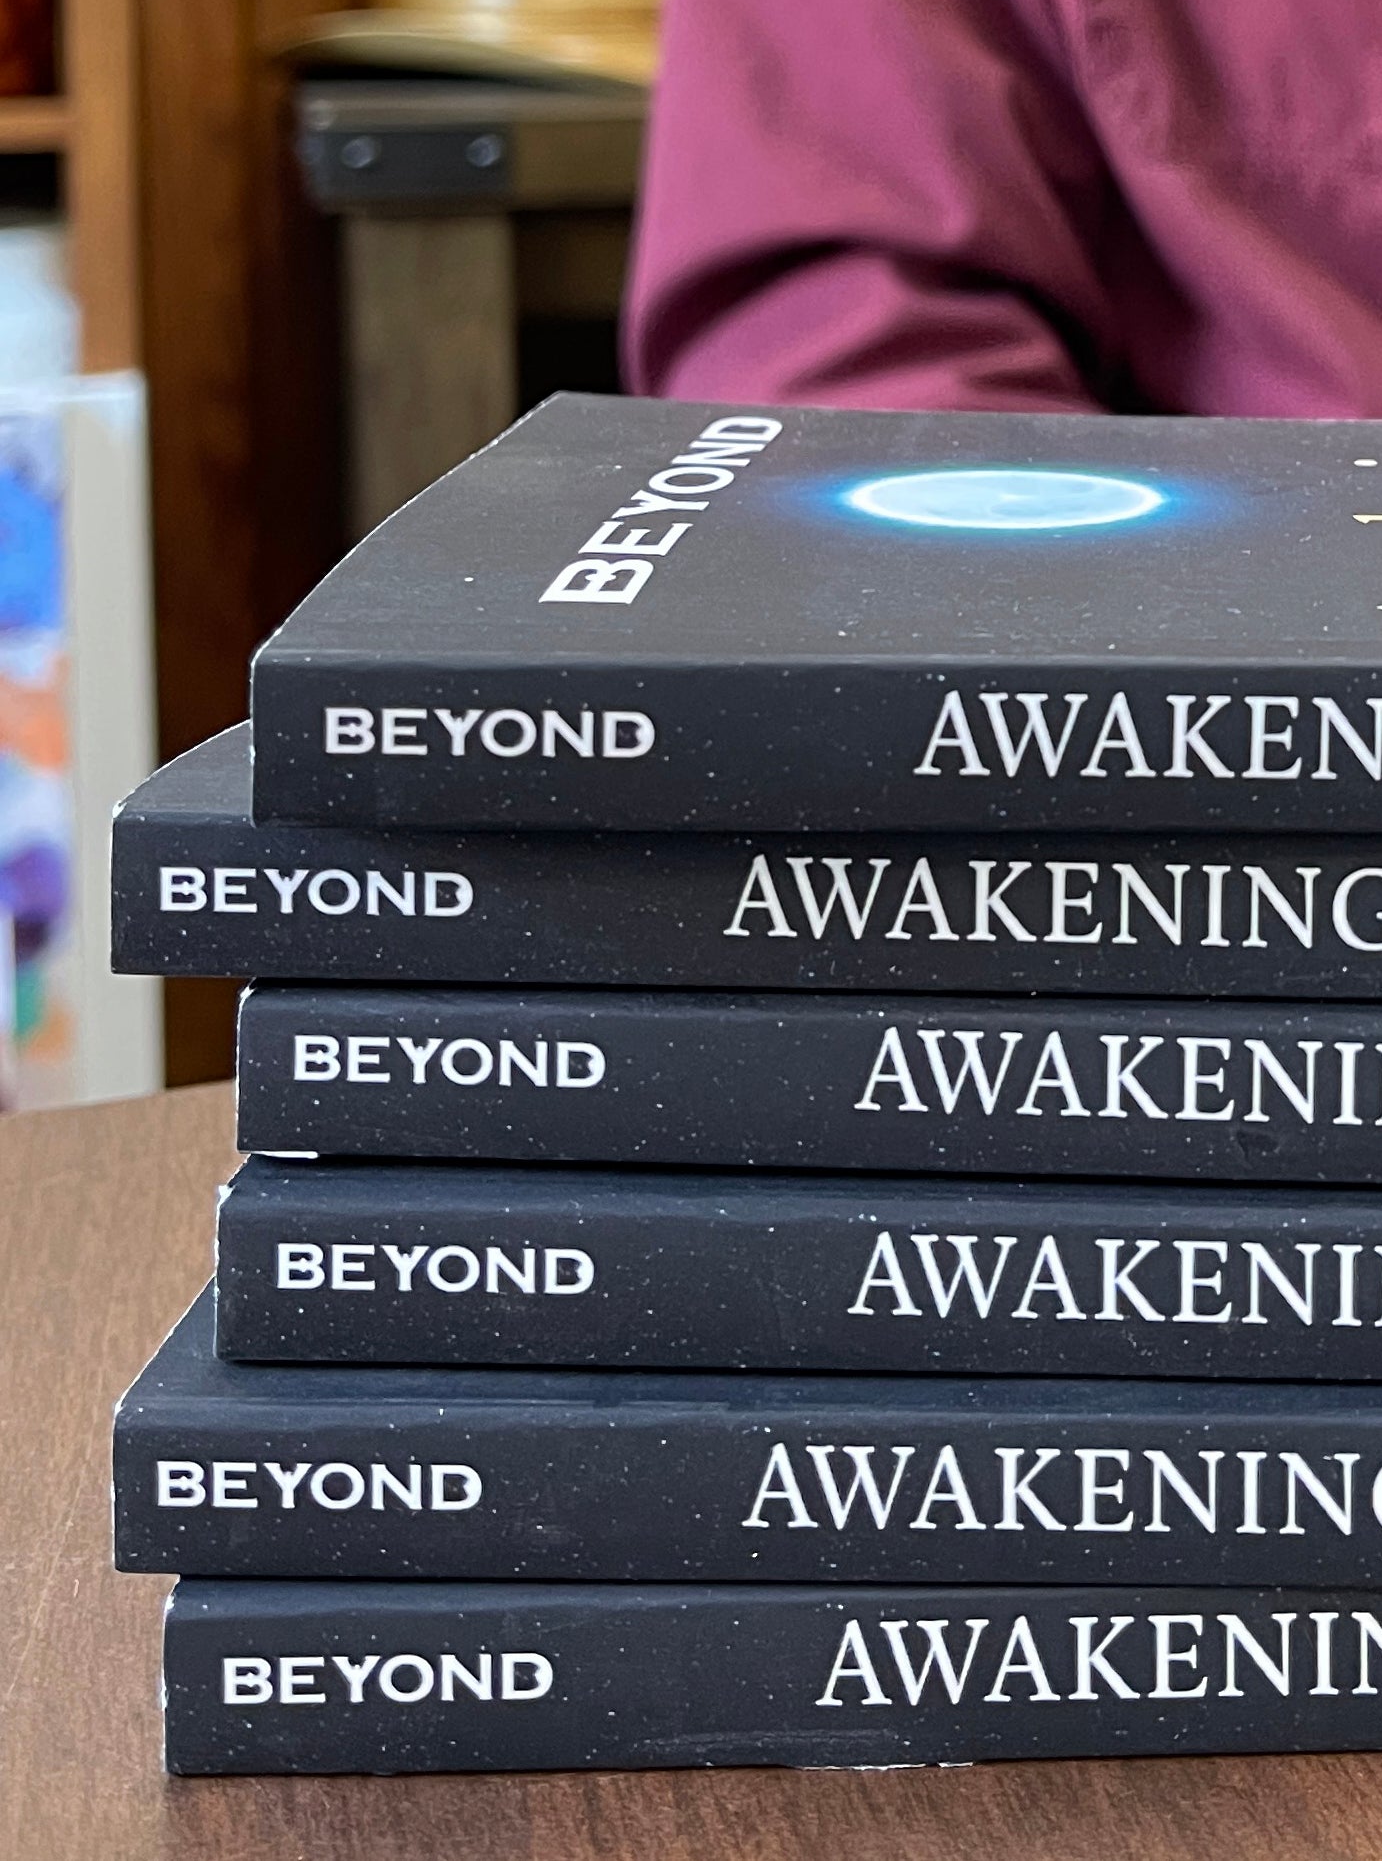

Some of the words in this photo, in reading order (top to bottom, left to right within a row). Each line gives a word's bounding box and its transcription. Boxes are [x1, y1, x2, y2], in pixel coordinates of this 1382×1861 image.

[538, 415, 783, 605] BEYOND
[324, 706, 656, 759] BEYOND
[158, 865, 475, 918] BEYOND
[292, 1033, 607, 1089] BEYOND
[275, 1241, 596, 1296] BEYOND
[155, 1459, 484, 1512] BEYOND
[222, 1651, 555, 1706] BEYOND
